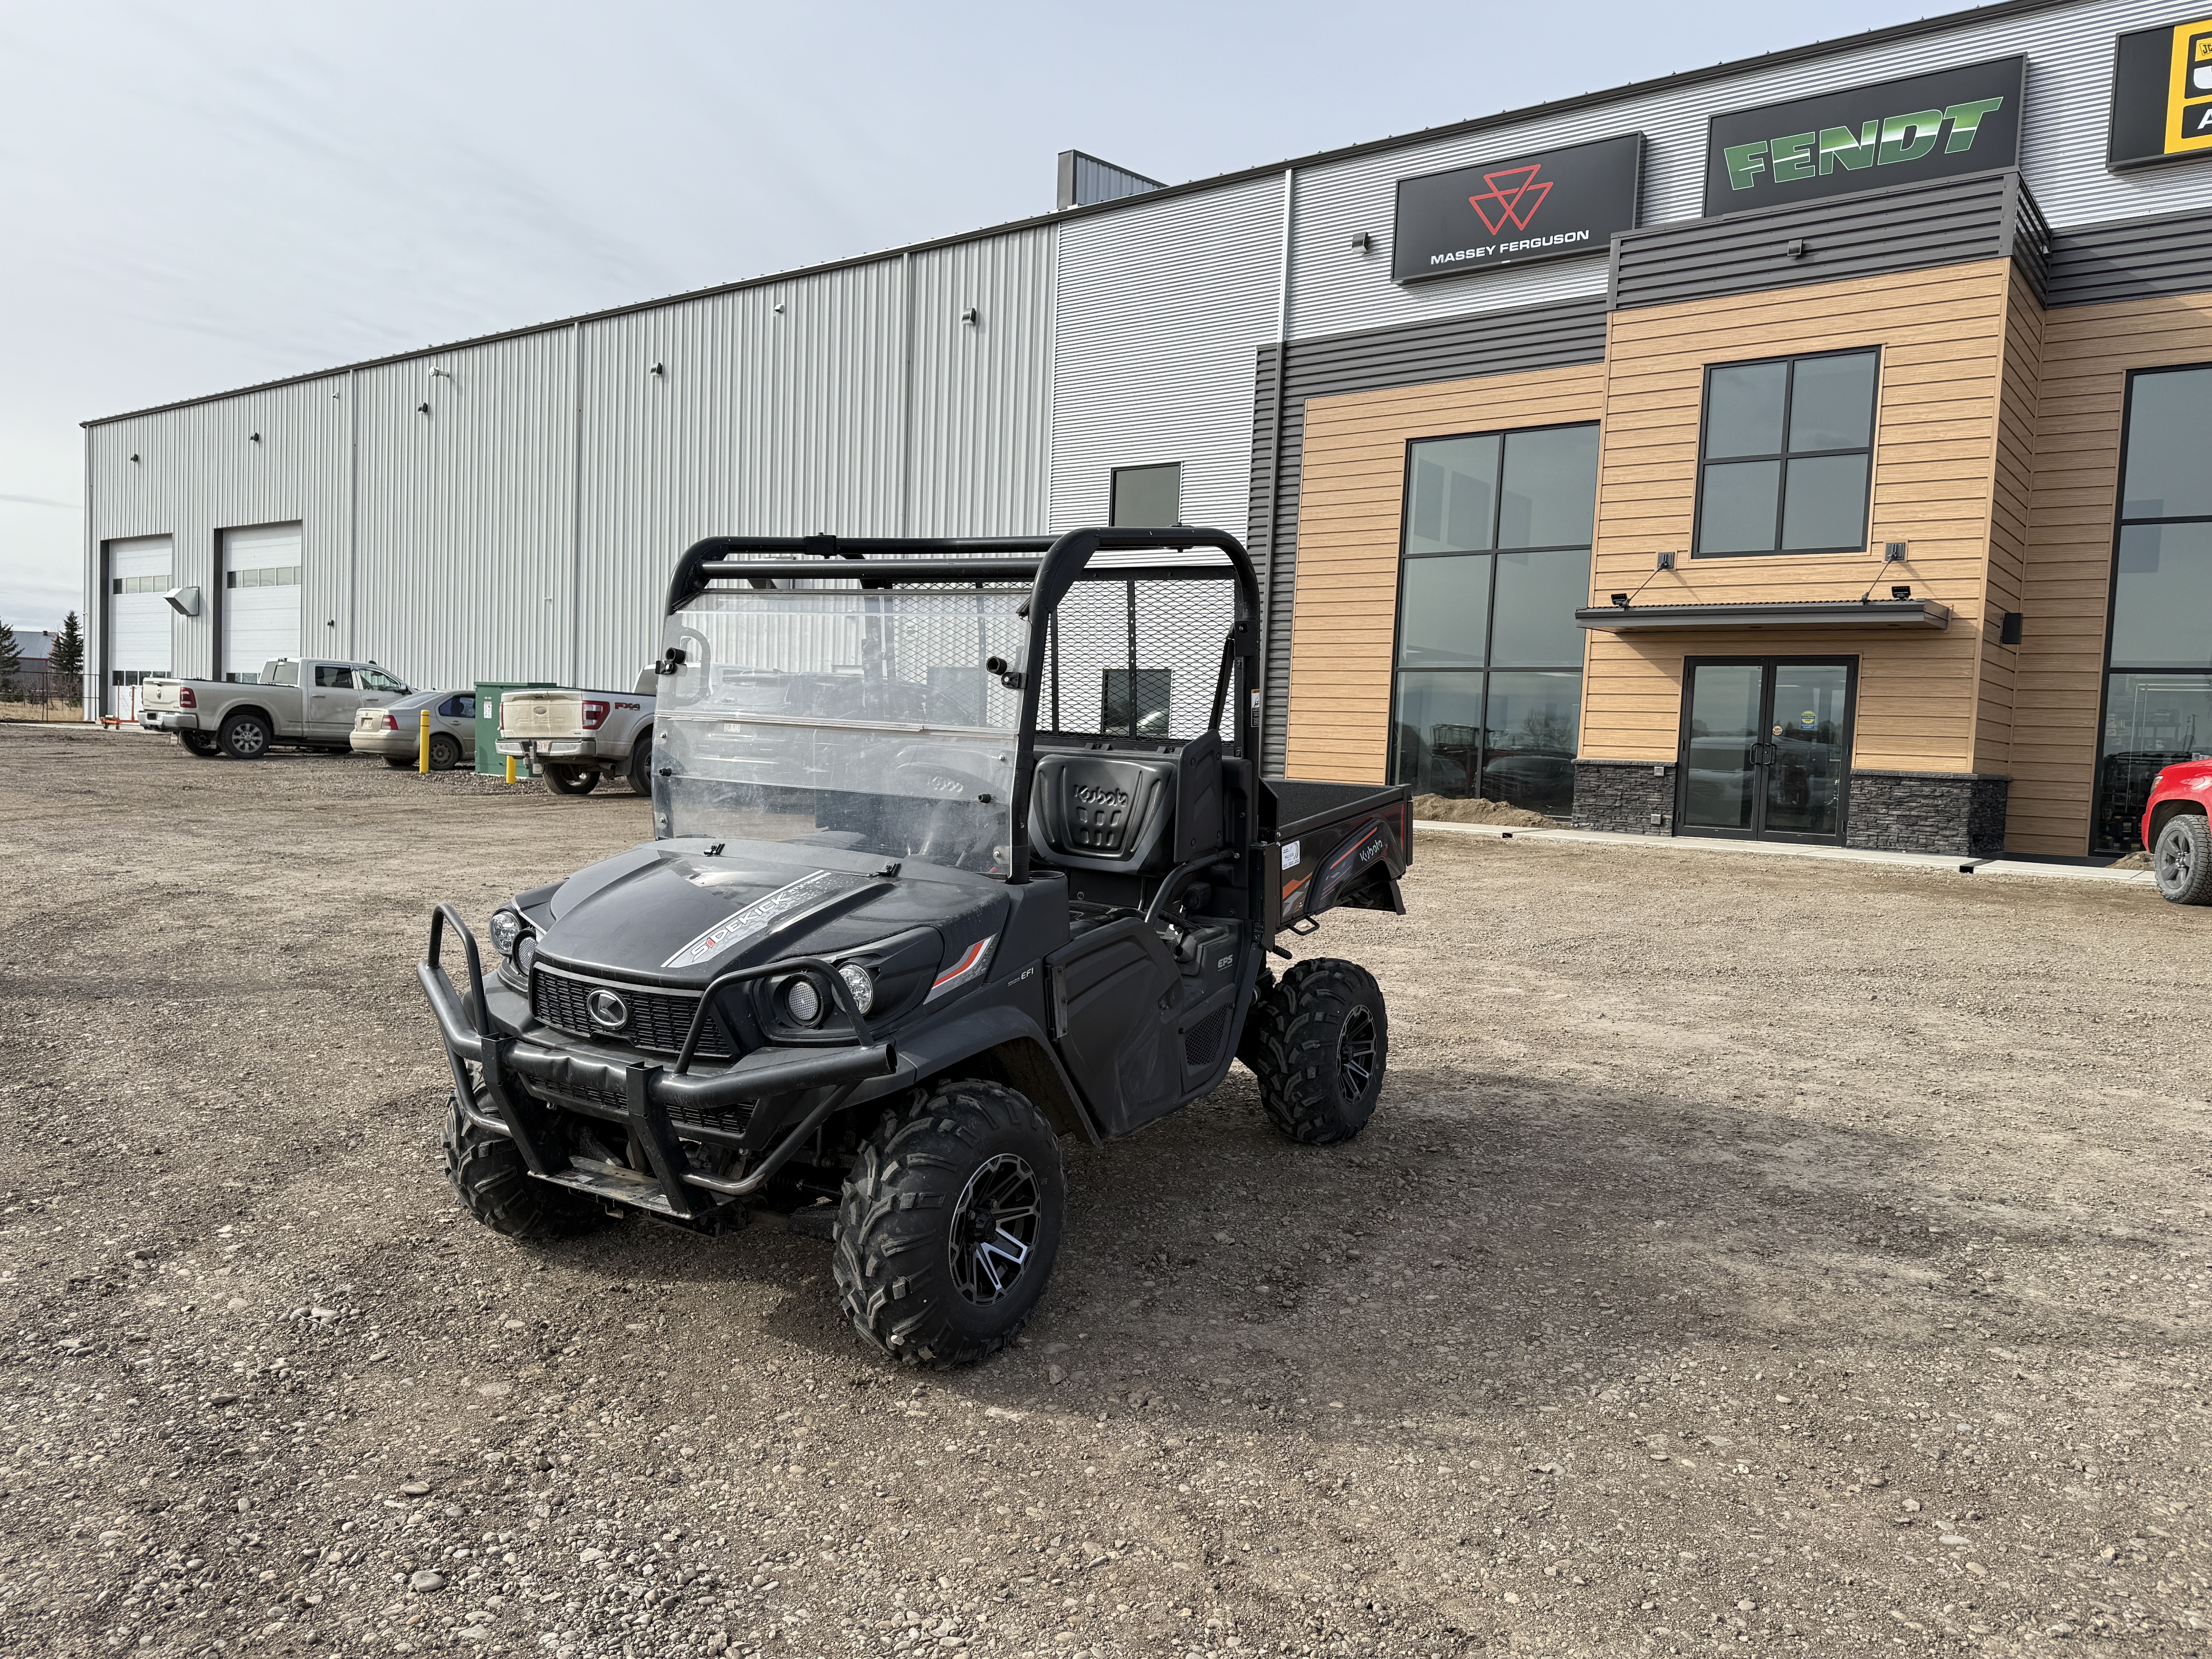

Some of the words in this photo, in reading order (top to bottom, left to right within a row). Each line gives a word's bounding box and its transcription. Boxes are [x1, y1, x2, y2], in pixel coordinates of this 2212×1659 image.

[2202, 44, 2212, 54] JC
[1724, 96, 2004, 190] FENDT
[1431, 245, 1496, 265] MASSEY
[1500, 230, 1589, 253] FERGUSON
[1074, 784, 1129, 807] Kubota
[1359, 839, 1383, 861] Kubota
[690, 891, 792, 963] SIDEKICK
[1218, 954, 1233, 968] EPS
[1021, 967, 1034, 980] EFI
